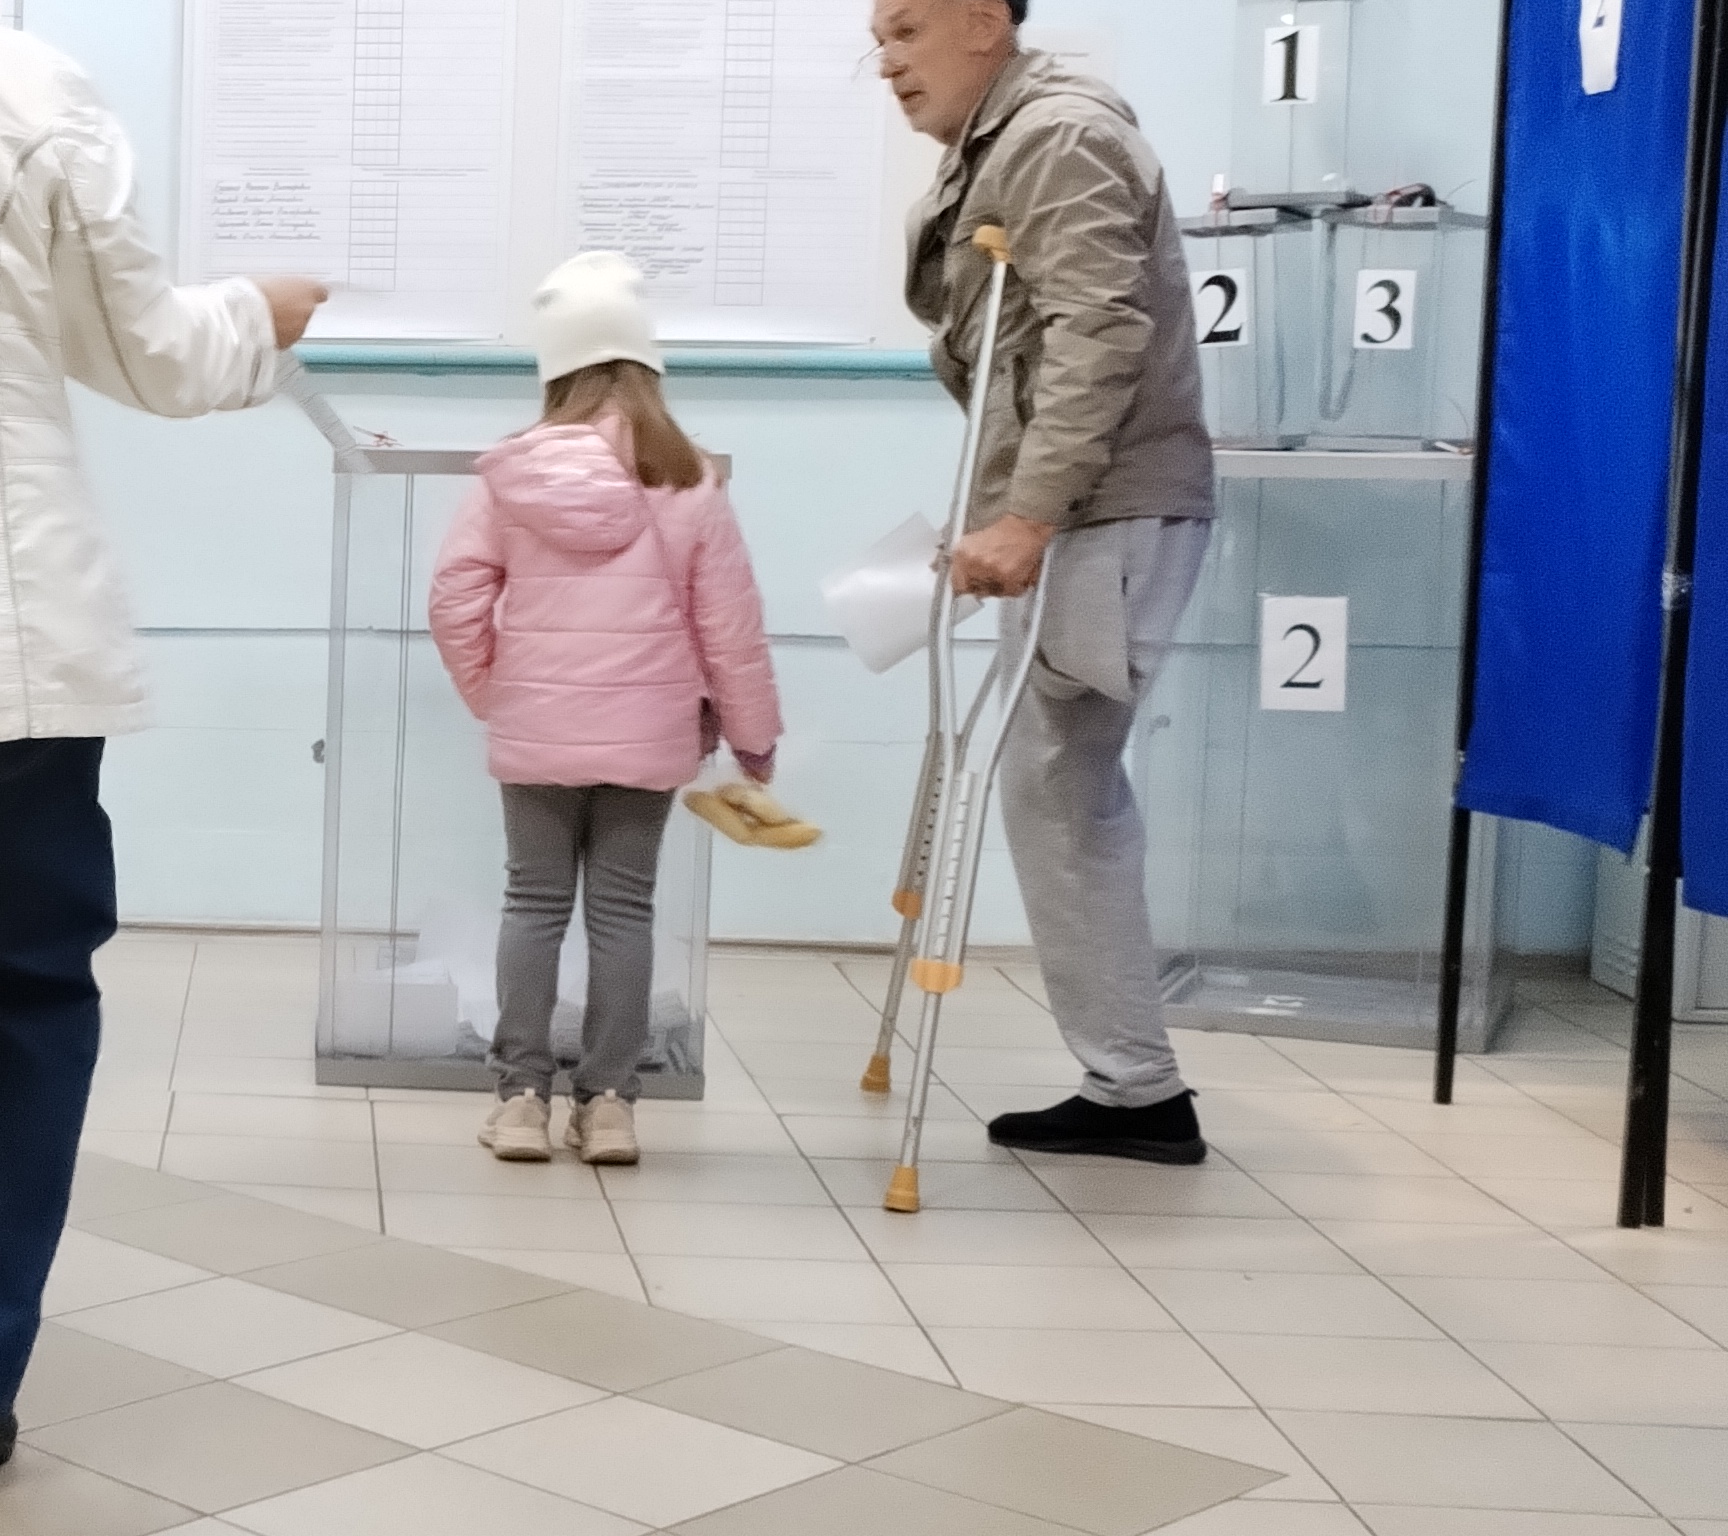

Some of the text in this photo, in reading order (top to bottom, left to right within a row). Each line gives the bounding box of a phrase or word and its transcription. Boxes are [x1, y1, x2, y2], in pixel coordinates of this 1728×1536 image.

[1270, 31, 1306, 104] 1
[1196, 276, 1241, 345] 2
[1360, 279, 1403, 345] 3
[1280, 624, 1324, 690] 2
